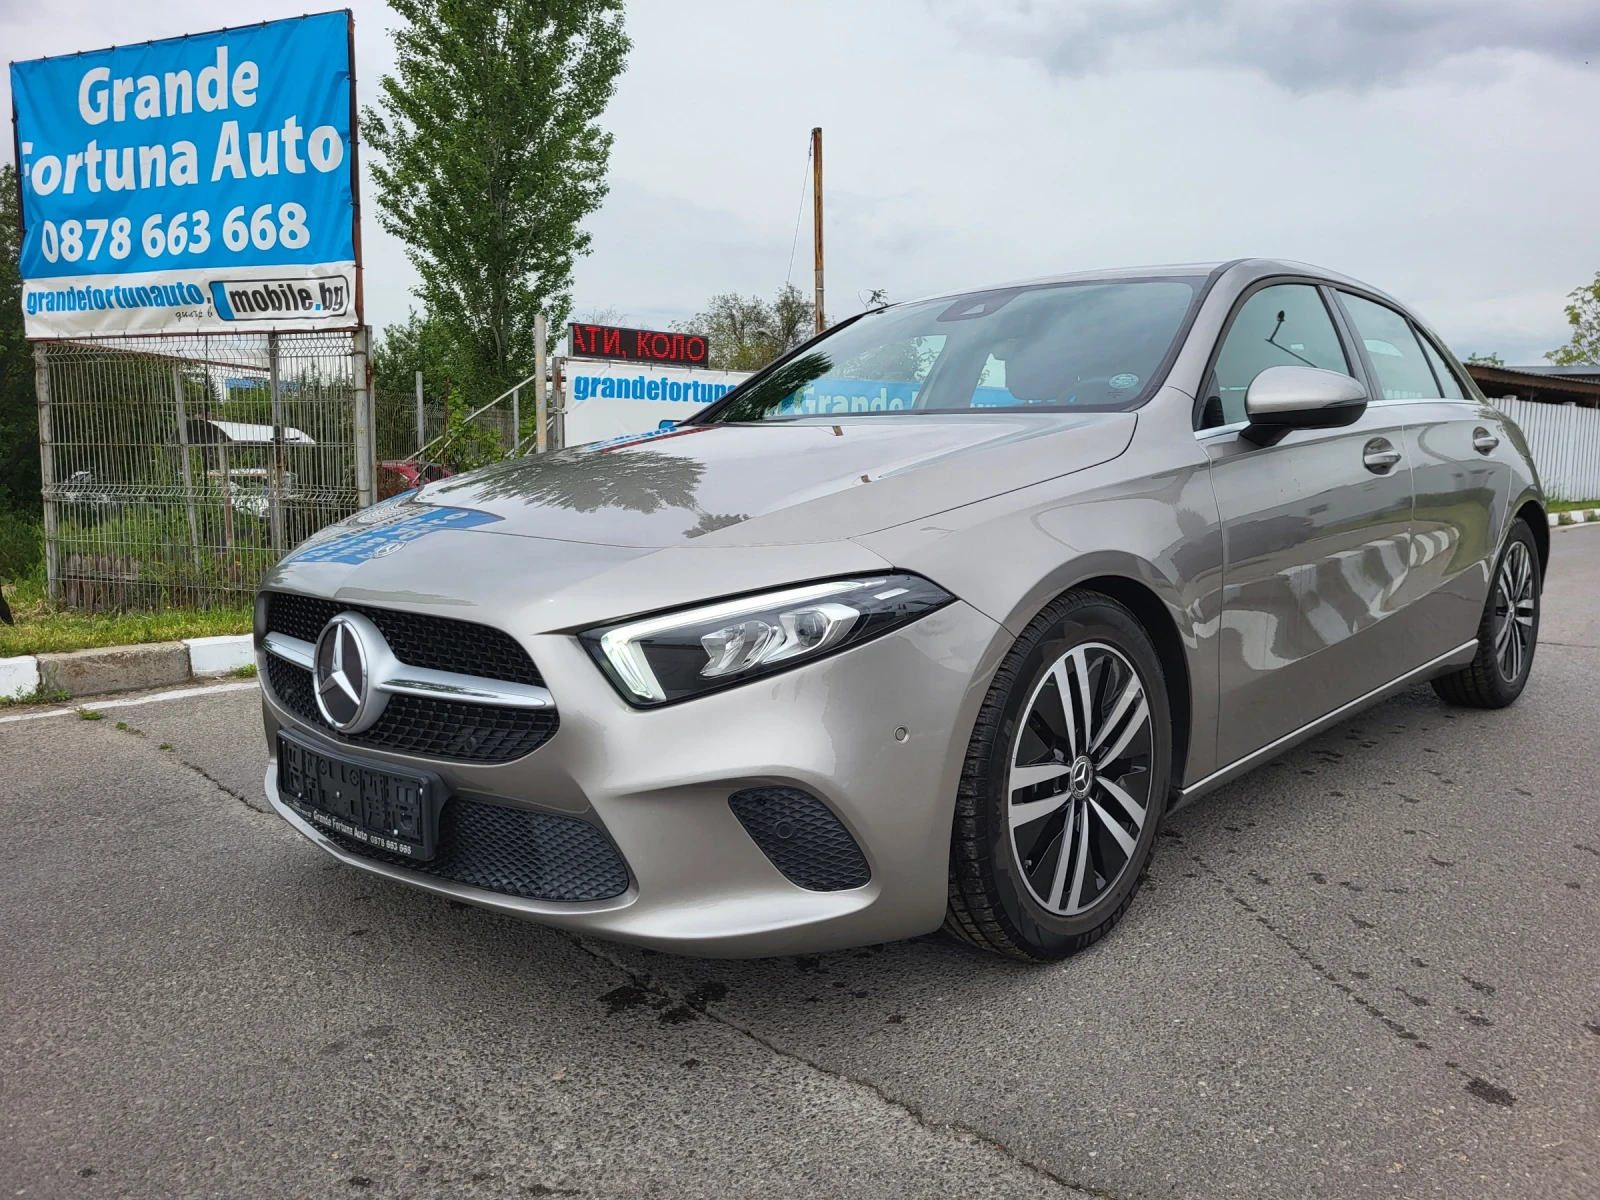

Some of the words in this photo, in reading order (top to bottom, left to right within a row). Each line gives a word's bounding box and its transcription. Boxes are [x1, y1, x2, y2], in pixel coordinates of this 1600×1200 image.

[78, 46, 259, 125] Grande
[211, 115, 344, 182] Auto
[41, 217, 132, 263] 0878
[141, 209, 210, 258] 663
[222, 202, 310, 252] 668
[228, 281, 344, 313] mobile.bg
[637, 331, 705, 361] КОЛО
[354, 827, 368, 842] Auto
